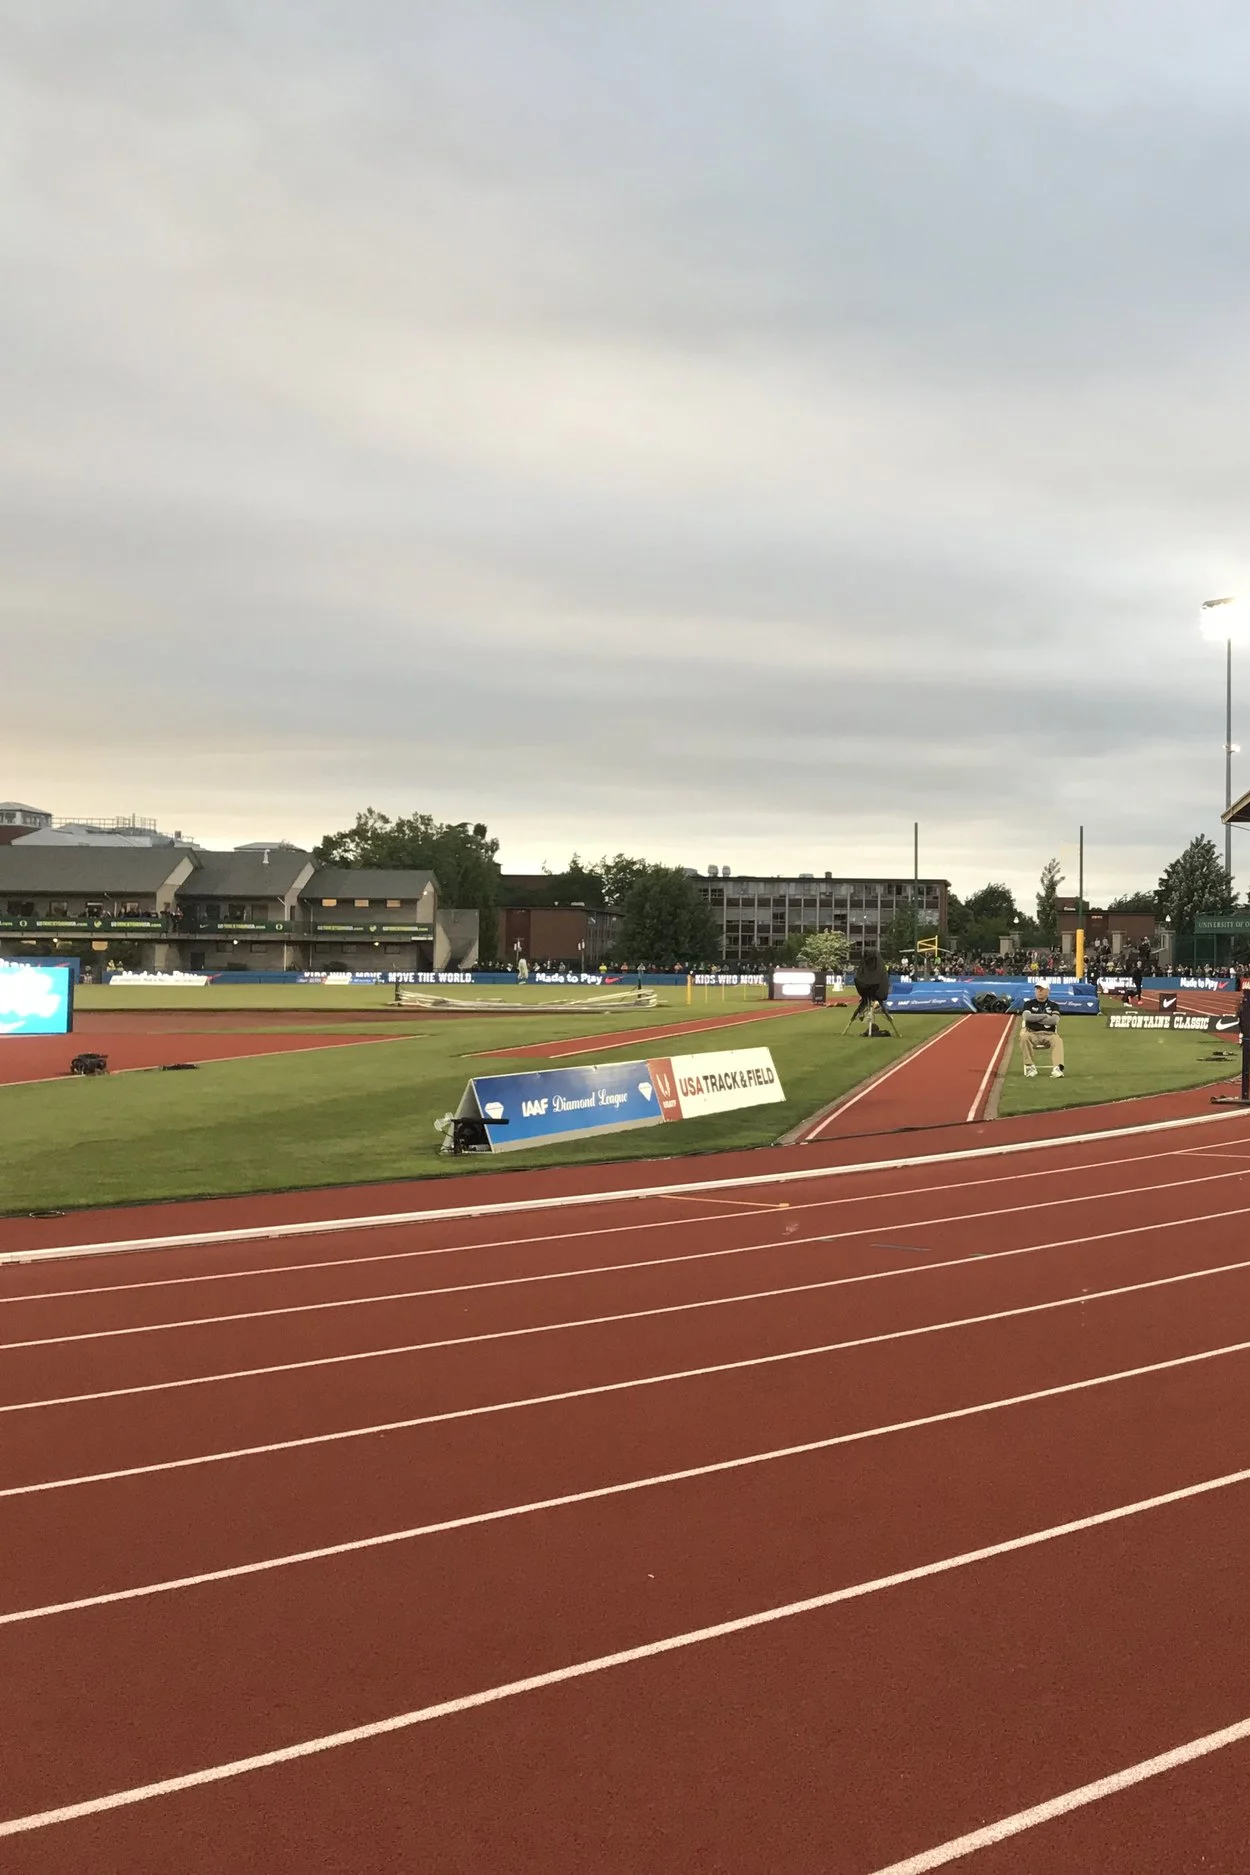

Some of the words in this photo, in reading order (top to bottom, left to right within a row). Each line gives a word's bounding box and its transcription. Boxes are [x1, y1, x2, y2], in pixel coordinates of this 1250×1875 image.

[1198, 921, 1233, 929] UNIVERSITY
[417, 971, 436, 983] THE
[438, 971, 475, 984] WORLD.
[535, 972, 565, 984] Made
[566, 973, 579, 984] to
[580, 973, 603, 986] Play
[695, 974, 716, 985] KIDS
[717, 974, 738, 985] WHO
[1180, 977, 1197, 988] Made
[1198, 978, 1205, 989] to
[1109, 1015, 1171, 1029] PREFONTAINE
[1173, 1016, 1210, 1030] CLASSIC
[521, 1098, 549, 1117] IAAF
[552, 1091, 596, 1113] Diamond
[597, 1088, 628, 1109] League
